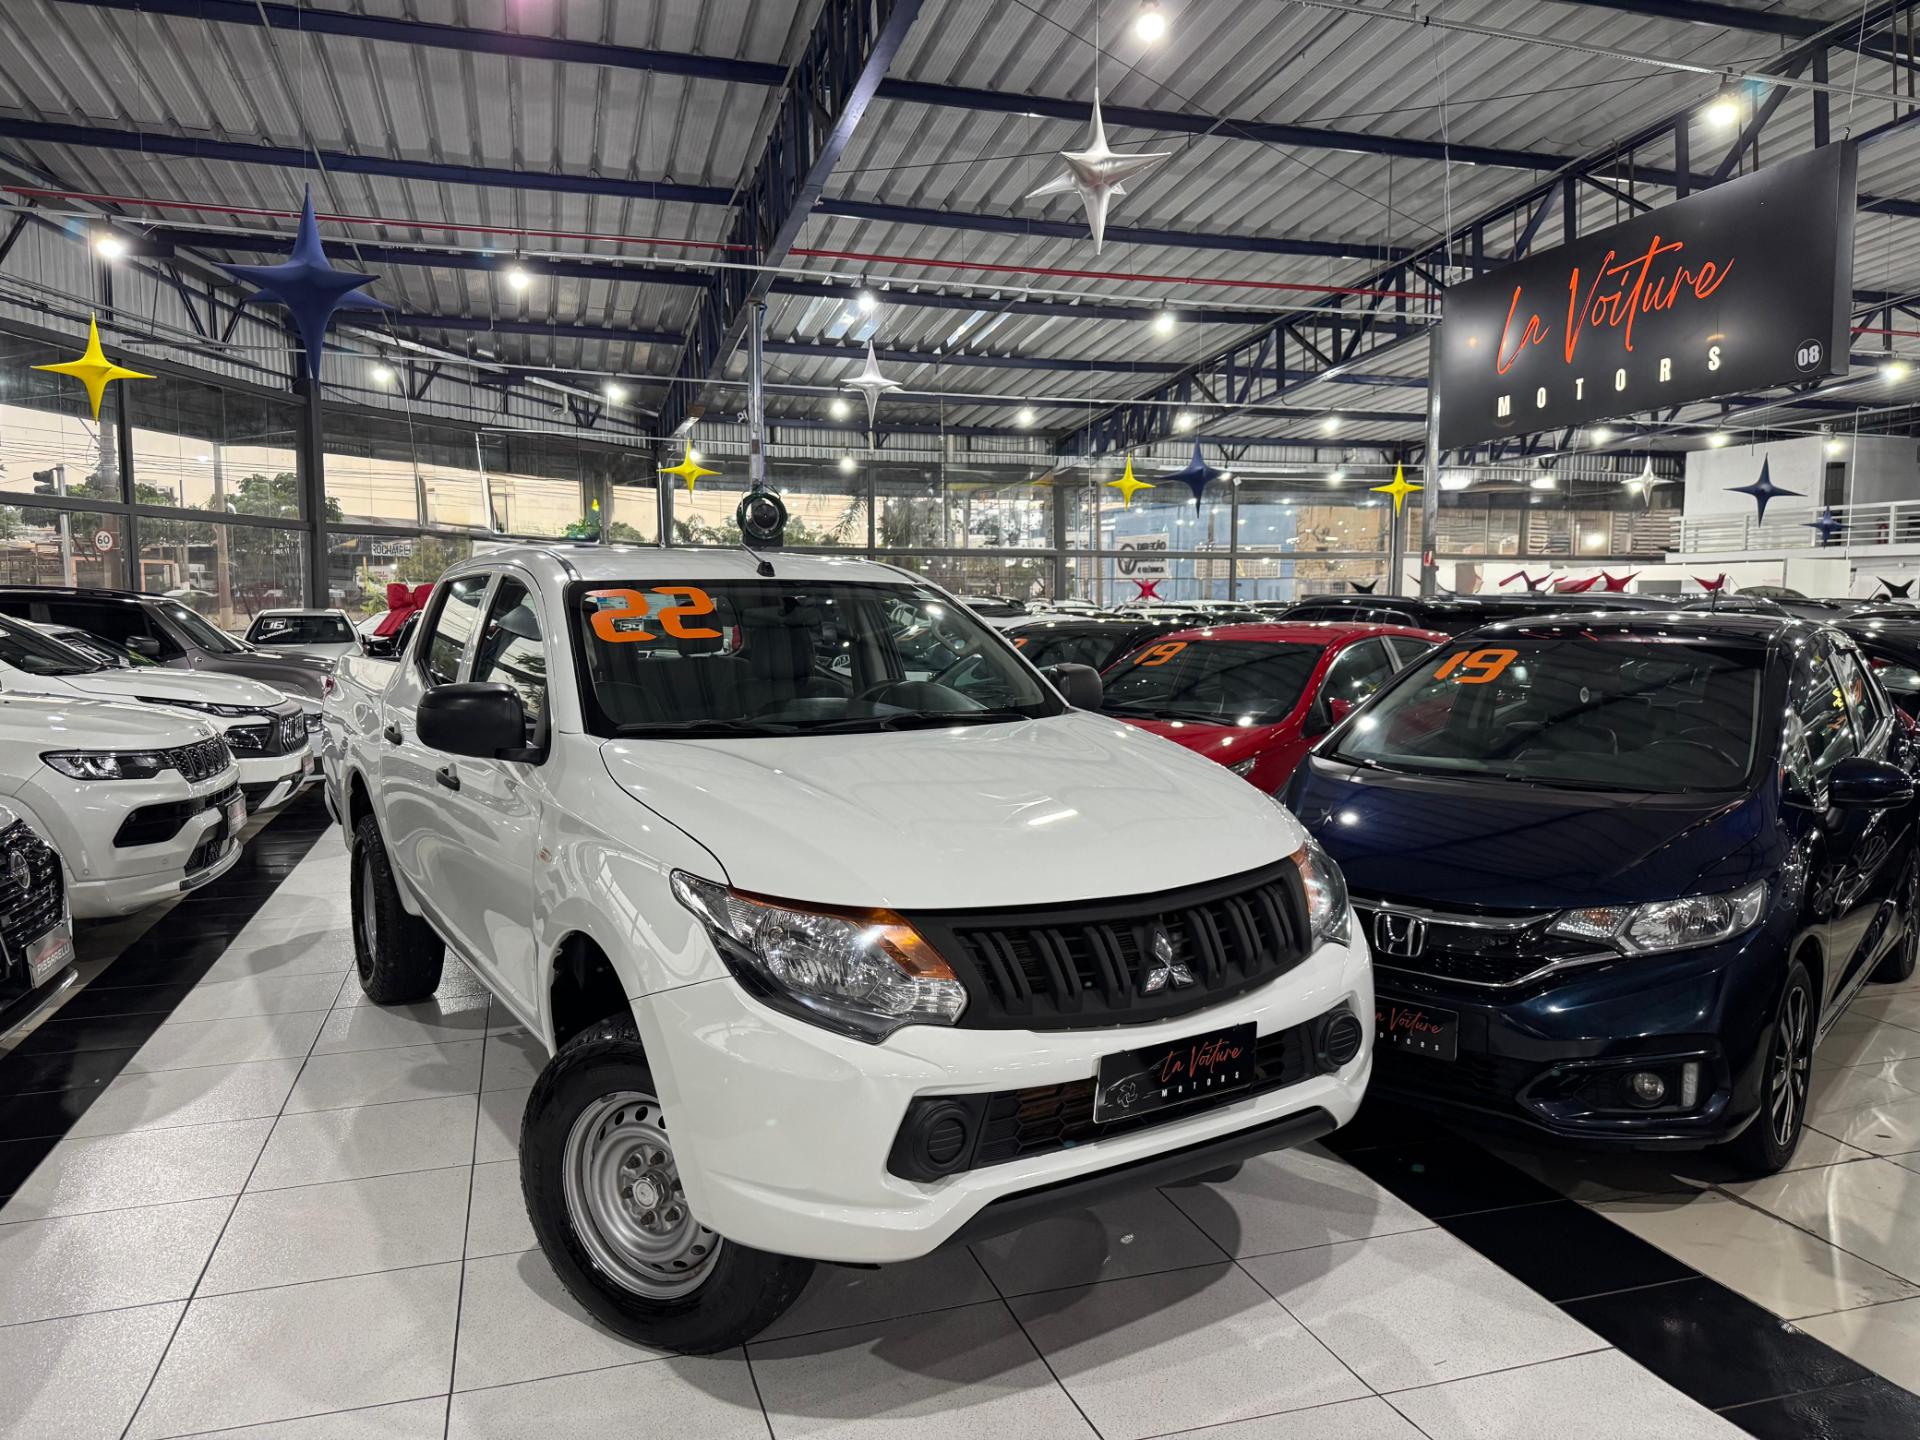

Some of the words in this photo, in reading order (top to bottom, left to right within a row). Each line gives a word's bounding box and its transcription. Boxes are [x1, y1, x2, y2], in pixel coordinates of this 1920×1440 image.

[1496, 285, 1550, 375] La
[1564, 234, 1735, 364] Voiture
[1797, 344, 1820, 367] 08
[1496, 345, 1722, 418] MOTORS
[97, 535, 110, 545] 60
[269, 620, 284, 630] 16
[584, 586, 723, 643] 22
[1134, 641, 1188, 667] 19
[1433, 648, 1519, 684] 19
[1390, 1007, 1444, 1036] Voiture
[1379, 1031, 1440, 1051] OTORS
[1161, 1050, 1186, 1083] La
[1189, 1038, 1244, 1078] Voiture
[1161, 1071, 1240, 1098] MOTORS
